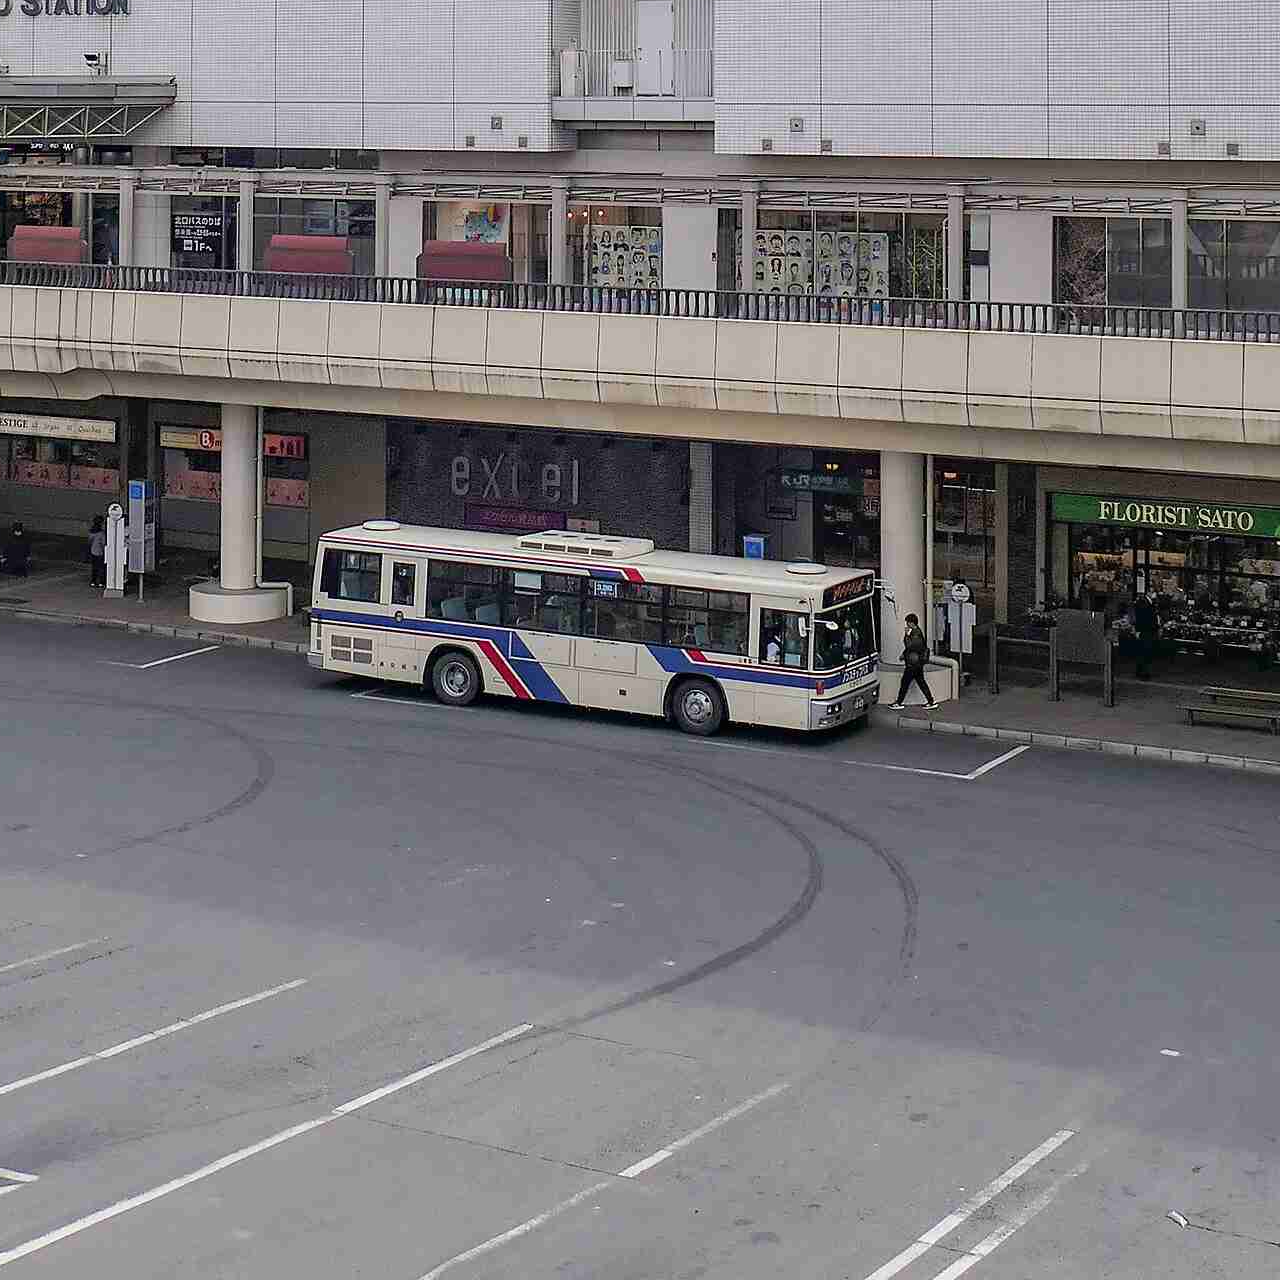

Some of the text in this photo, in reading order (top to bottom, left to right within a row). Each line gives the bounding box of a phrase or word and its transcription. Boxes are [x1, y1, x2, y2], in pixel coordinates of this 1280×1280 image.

[174, 216, 222, 227] 北口バスのりば
[1098, 500, 1255, 532] FLORIST SATO
